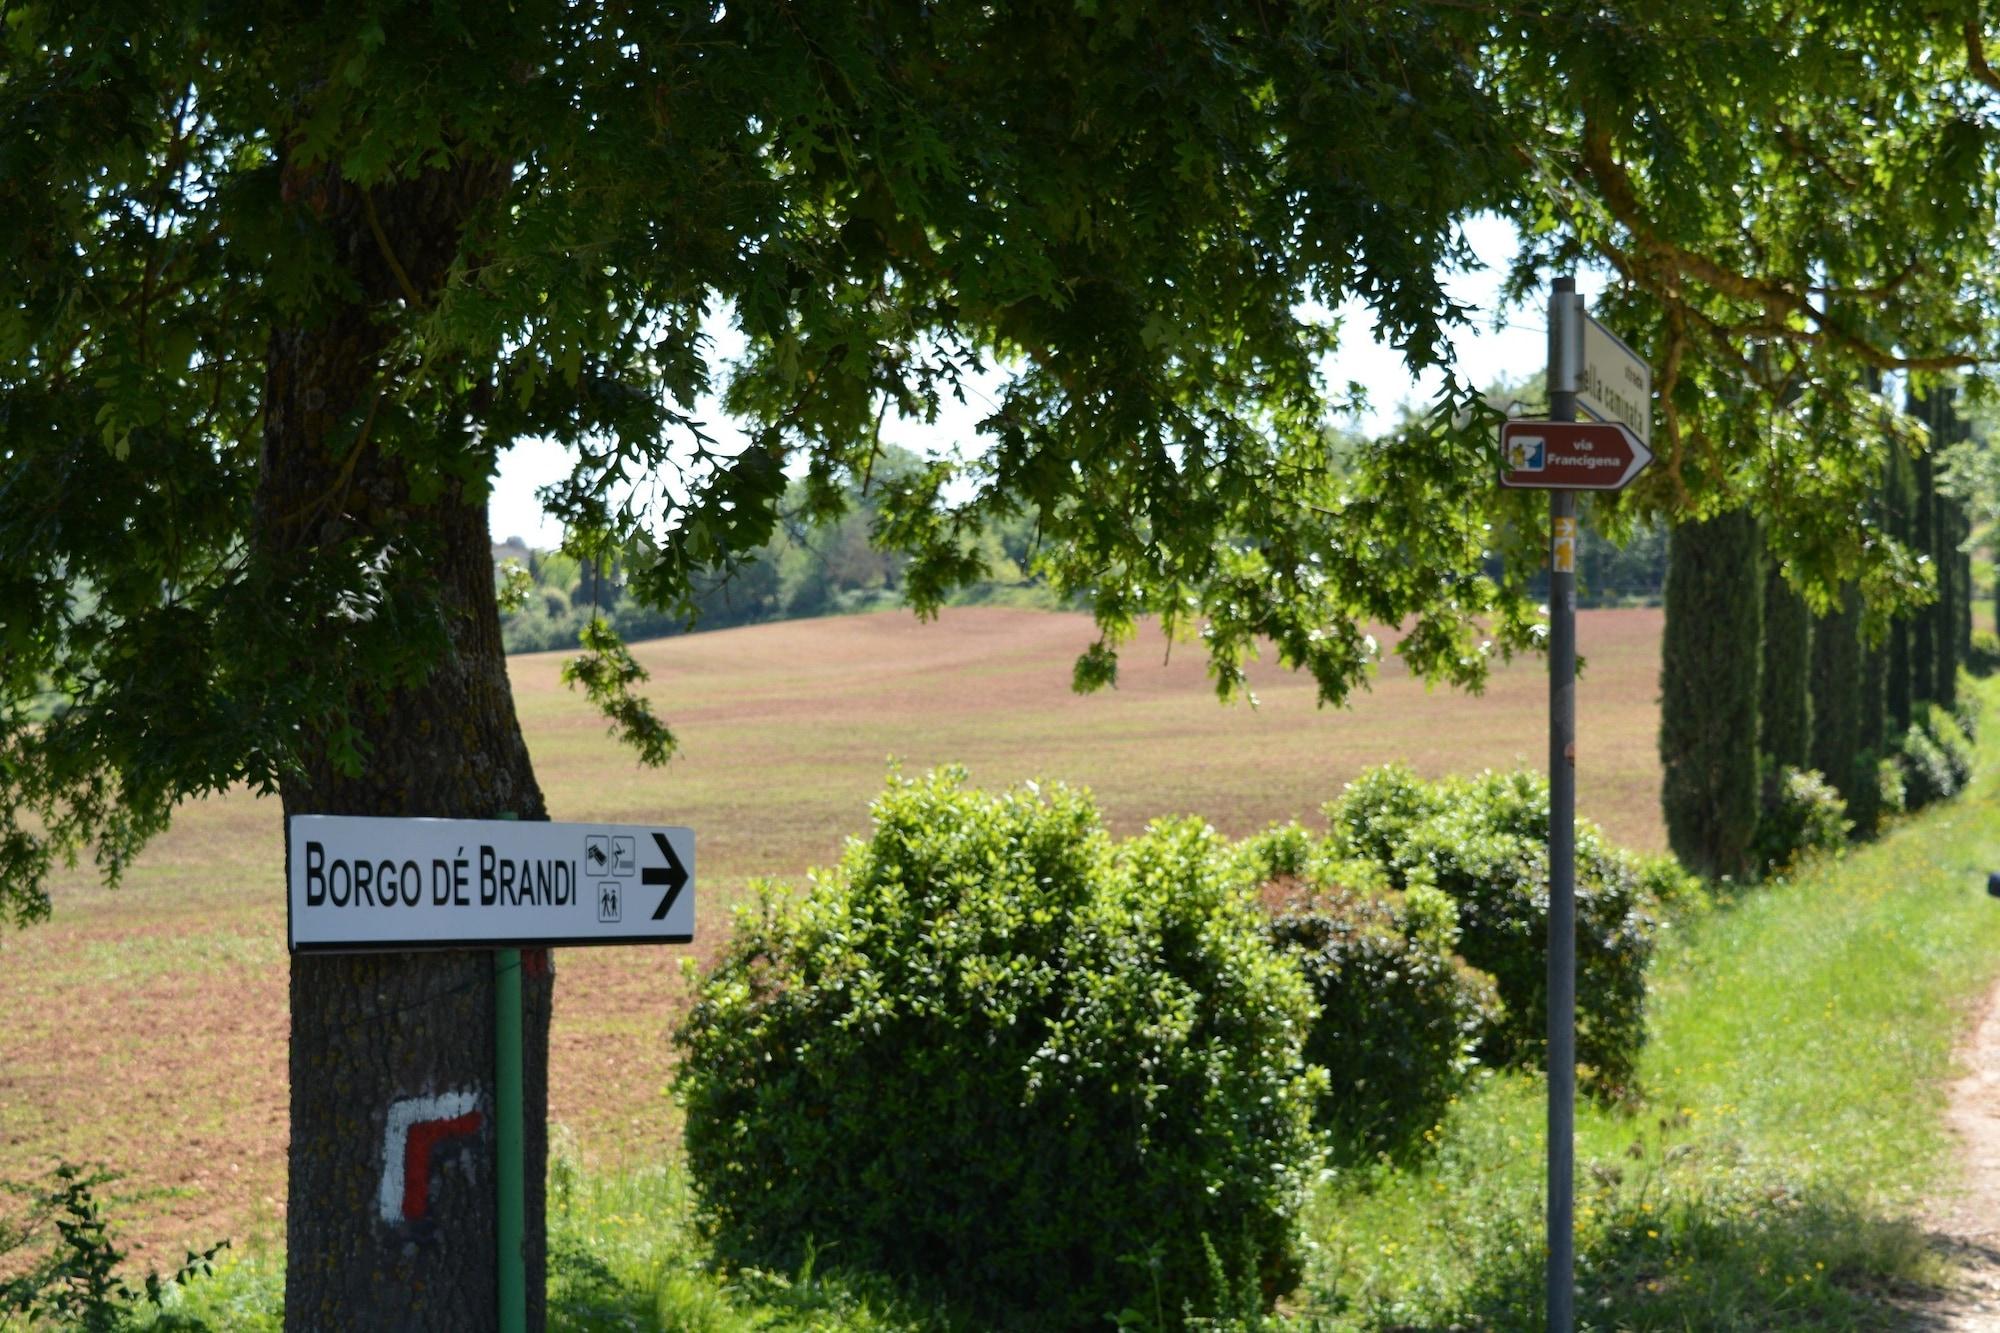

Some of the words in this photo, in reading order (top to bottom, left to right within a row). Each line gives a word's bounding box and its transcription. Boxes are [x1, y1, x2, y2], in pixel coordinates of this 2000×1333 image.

[1583, 362, 1602, 404] ella
[1573, 439, 1593, 451] via
[1547, 453, 1620, 468] Francigena
